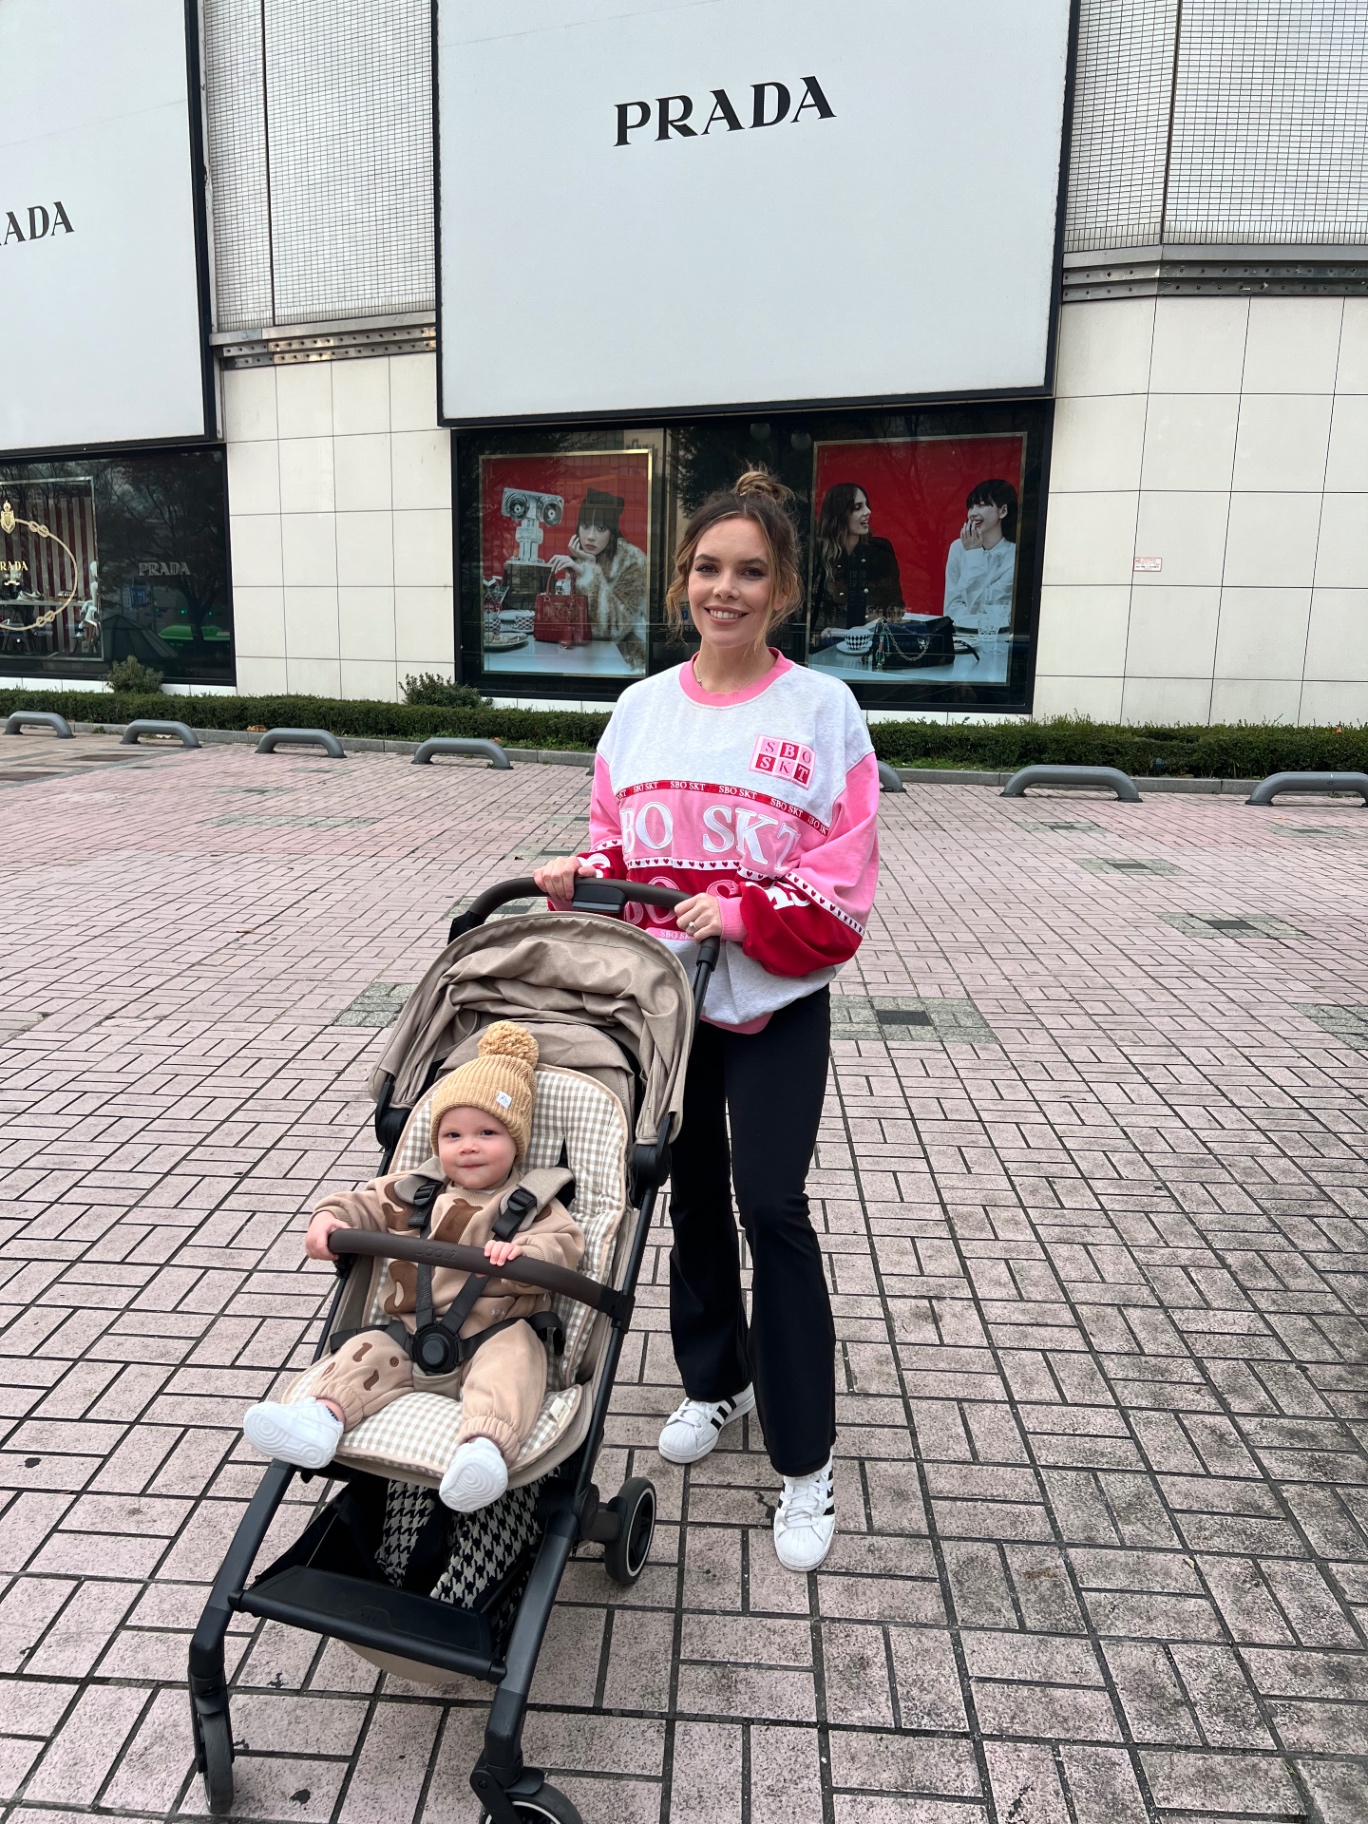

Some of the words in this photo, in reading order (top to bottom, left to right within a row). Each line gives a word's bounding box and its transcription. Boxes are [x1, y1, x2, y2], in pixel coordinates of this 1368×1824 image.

[613, 75, 837, 147] PRADA
[0, 200, 75, 246] ADA
[138, 561, 191, 576] PRADA
[645, 781, 659, 790] SKT
[670, 780, 688, 789] SBO
[689, 782, 706, 791] SKT
[718, 785, 738, 795] SBO
[738, 790, 758, 800] SKT
[770, 798, 788, 811] SBO
[788, 805, 804, 818] SKT
[702, 804, 801, 872] SKT
[660, 930, 678, 940] SBO
